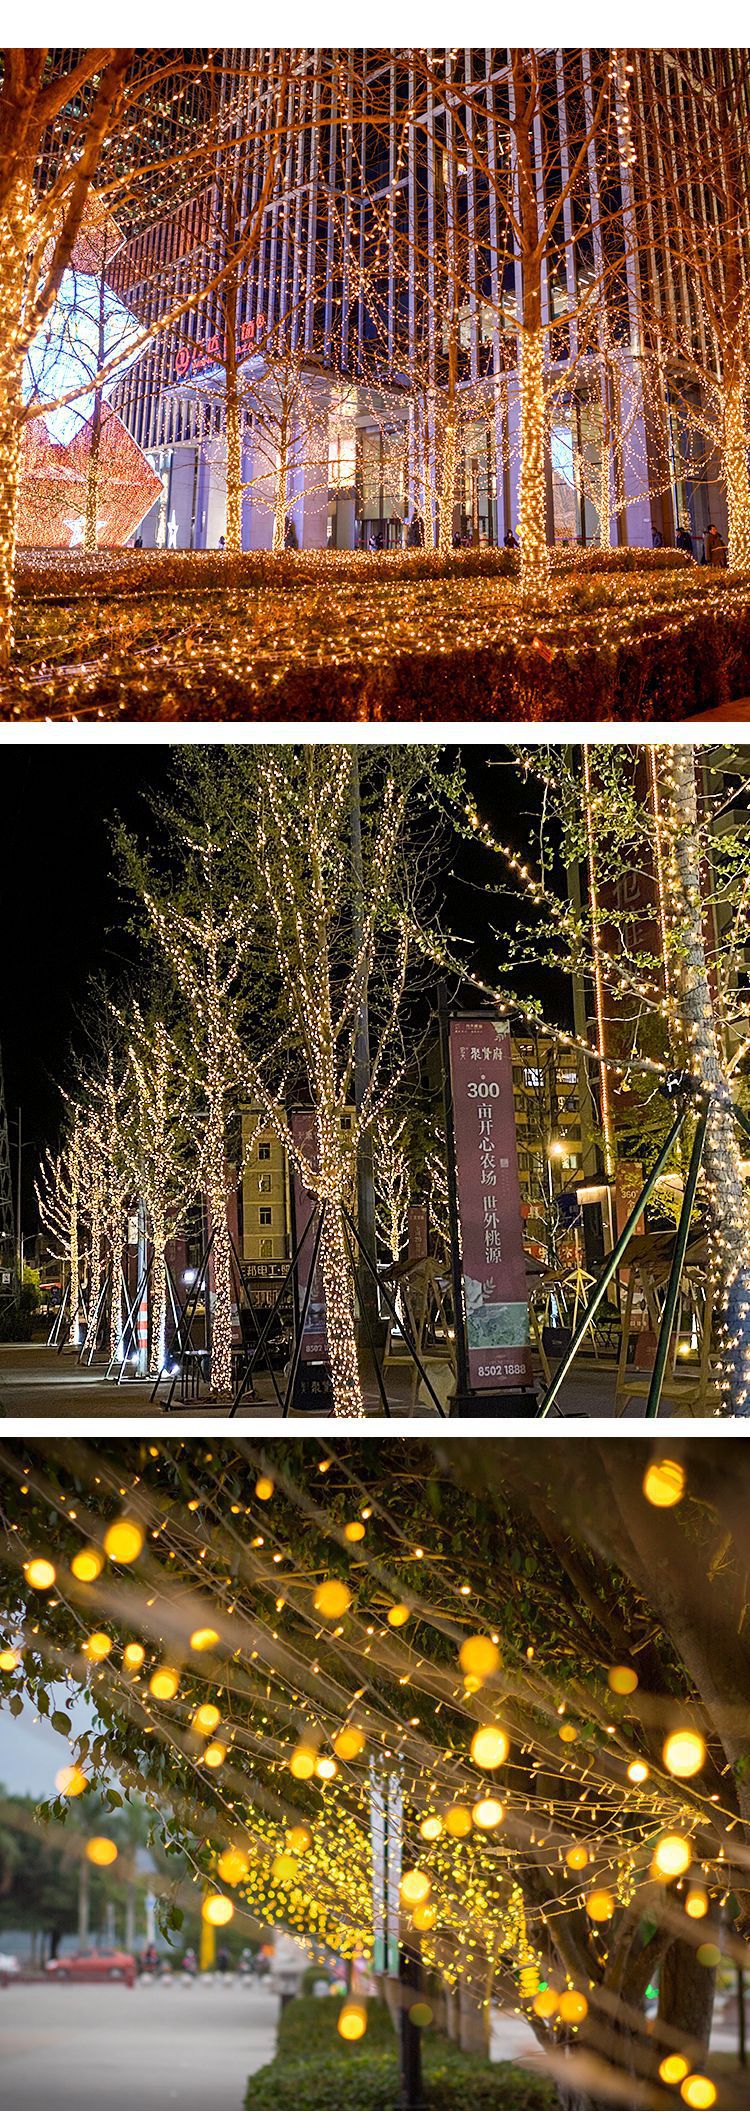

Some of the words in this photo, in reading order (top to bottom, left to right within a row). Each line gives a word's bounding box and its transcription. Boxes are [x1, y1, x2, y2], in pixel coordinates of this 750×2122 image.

[470, 1047, 503, 1061] 聚贤府
[467, 1082, 500, 1098] 300
[477, 1103, 497, 1186] 亩开心农场
[483, 1196, 502, 1264] 世外桃源
[478, 1365, 502, 1377] 8502
[503, 1364, 527, 1375] 1888
